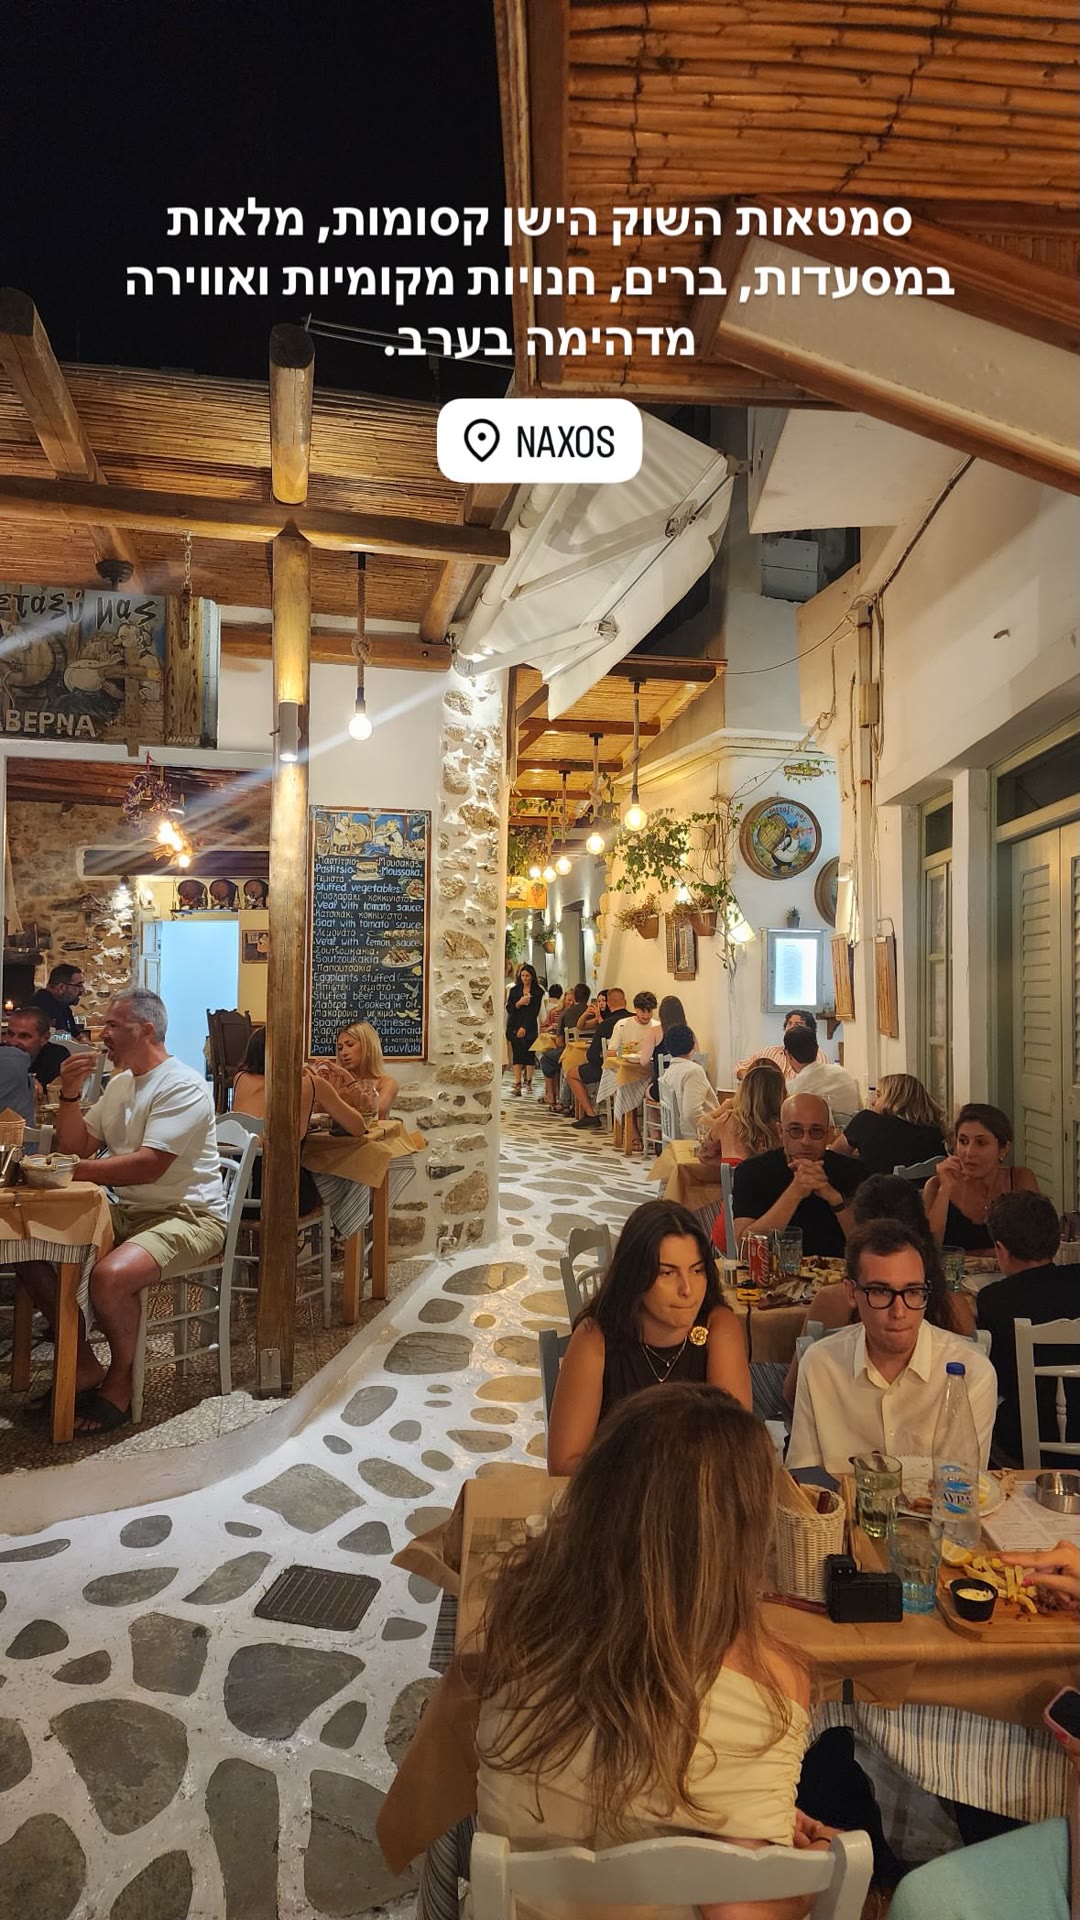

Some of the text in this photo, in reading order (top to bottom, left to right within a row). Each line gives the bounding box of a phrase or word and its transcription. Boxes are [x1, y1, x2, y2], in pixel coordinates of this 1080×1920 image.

[96, 596, 157, 631] μας
[0, 709, 97, 738] ΒΕΡΝΑ
[315, 882, 347, 892] Stuffed
[316, 900, 338, 910] Veal
[340, 901, 359, 910] with
[363, 902, 391, 911] tomato
[315, 918, 336, 928] Goat
[340, 919, 356, 928] with
[360, 920, 390, 929] tomato
[315, 936, 337, 946] Veal
[341, 937, 359, 946] with
[365, 936, 391, 947] lemon
[313, 972, 359, 984] Eggplants
[362, 970, 396, 983] stuffed
[313, 990, 347, 1000] Stuffed
[352, 990, 374, 1000] beef
[358, 1000, 391, 1010] Cooked
[393, 1001, 402, 1009] in
